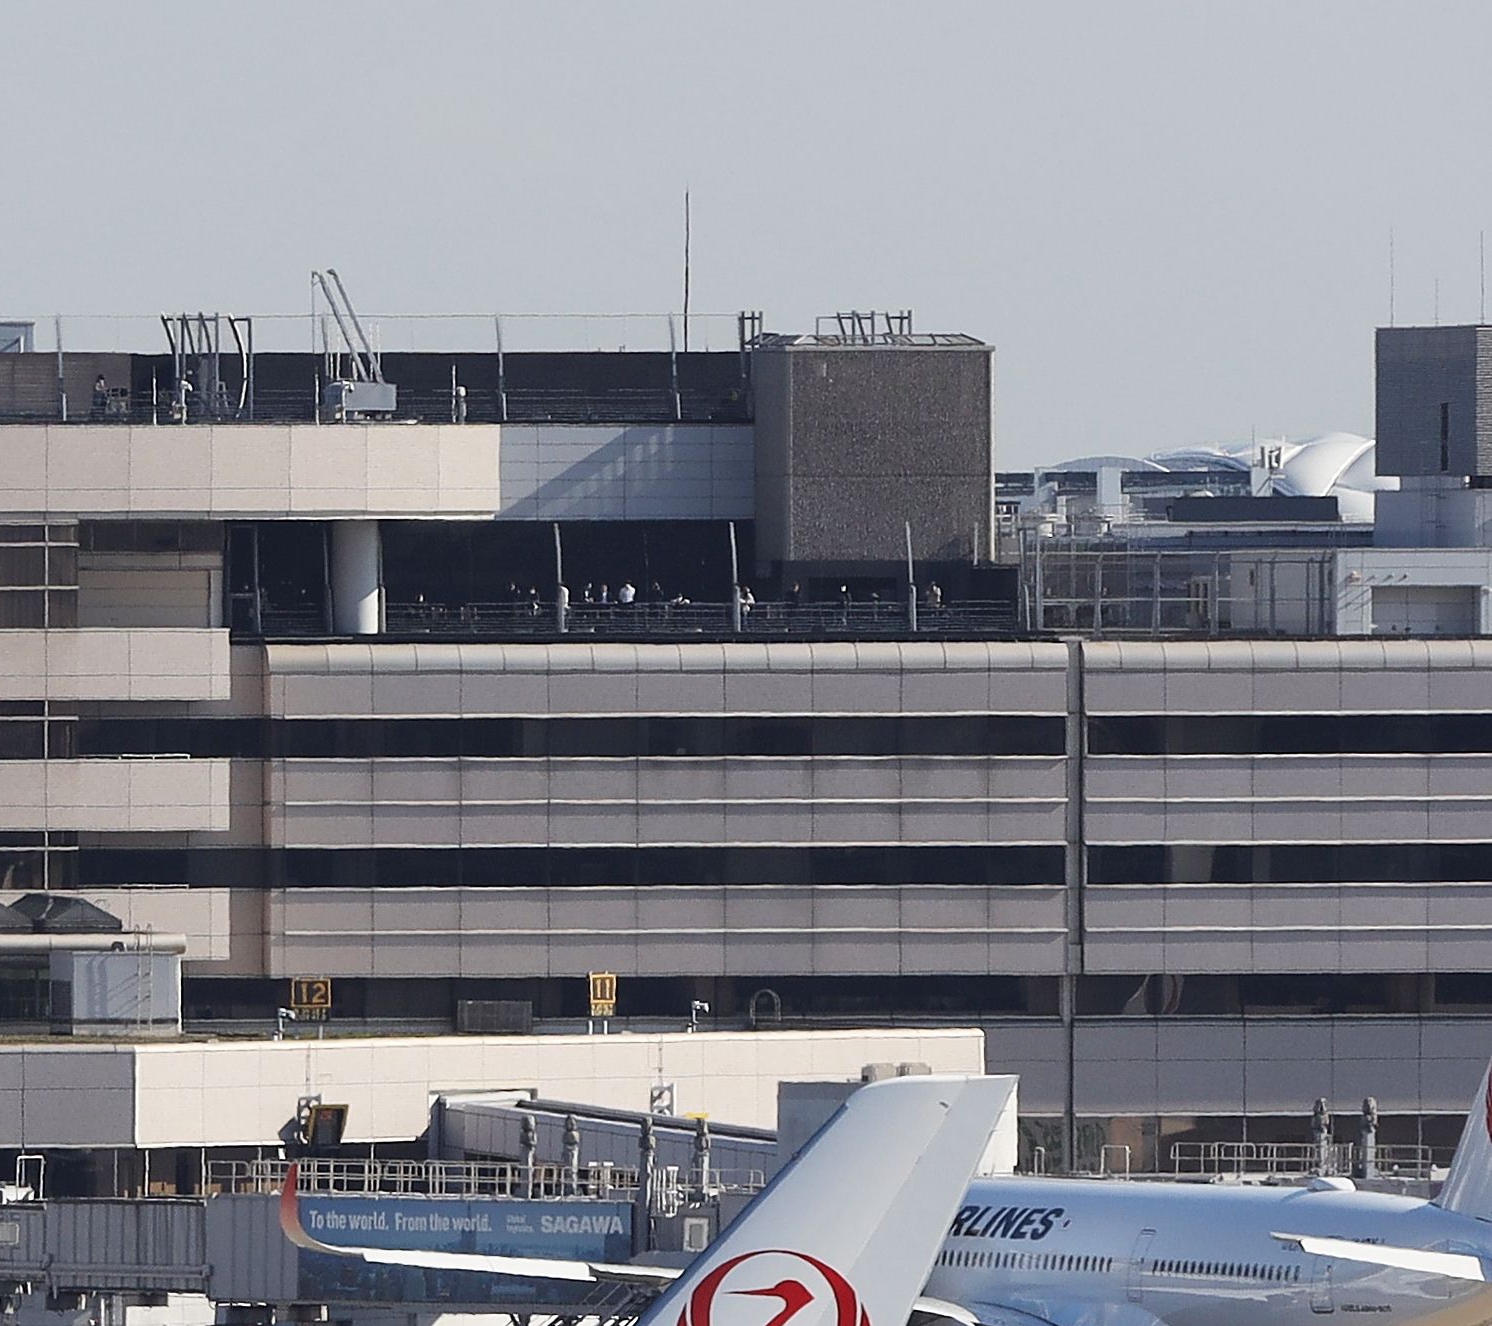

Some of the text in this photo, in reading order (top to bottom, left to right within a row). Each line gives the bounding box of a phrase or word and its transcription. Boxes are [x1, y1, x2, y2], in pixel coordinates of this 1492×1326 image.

[301, 982, 326, 1003] 12
[596, 978, 610, 999] 11
[309, 1210, 493, 1232] To the world. From the world.
[541, 1215, 623, 1234] SAGAWA
